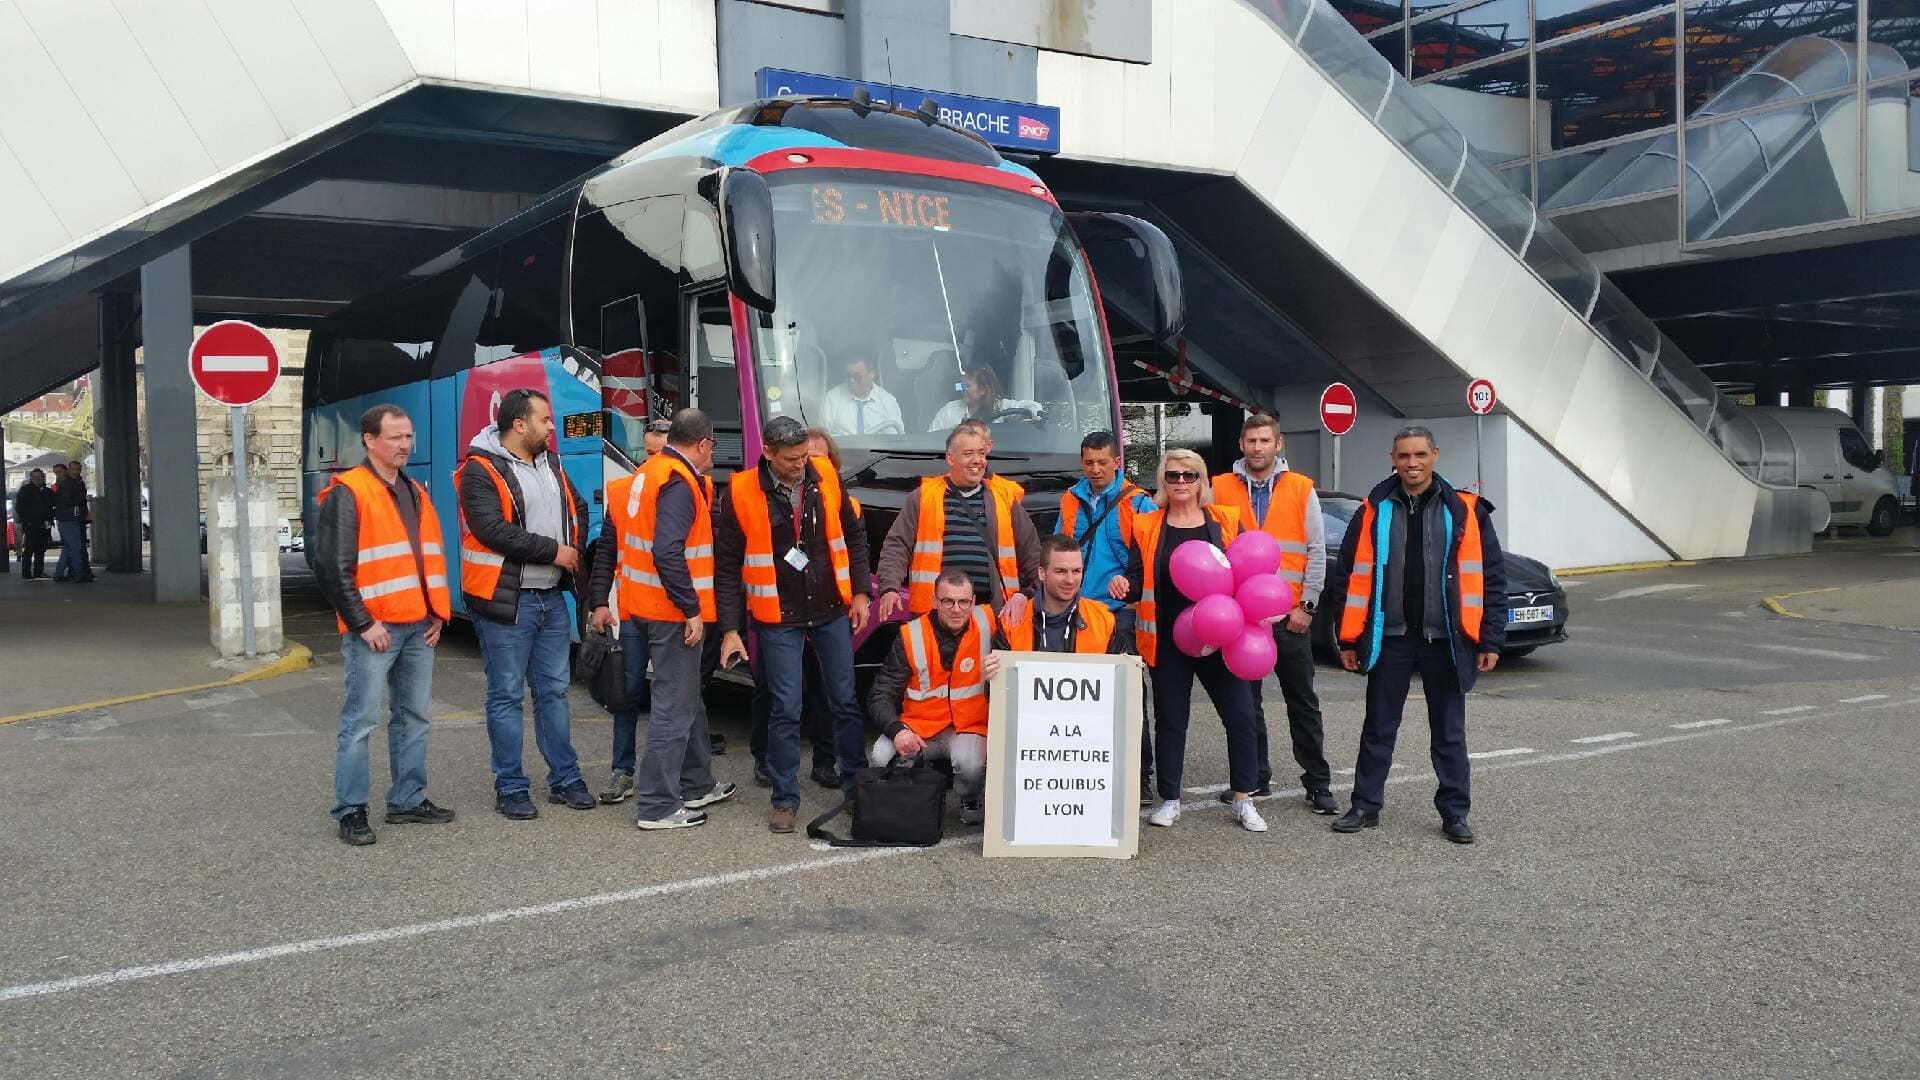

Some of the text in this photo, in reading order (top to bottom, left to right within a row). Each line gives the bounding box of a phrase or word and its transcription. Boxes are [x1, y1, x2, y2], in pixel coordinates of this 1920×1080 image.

[919, 105, 1010, 134] RRACHE
[1020, 125, 1048, 137] SNCF
[878, 190, 950, 228] NICE
[1033, 677, 1101, 702] NON
[1049, 724, 1082, 737] A LA
[1020, 749, 1110, 763] FERMETURE
[1023, 778, 1106, 791] DE OUIBUS
[1044, 803, 1084, 816] LYON
